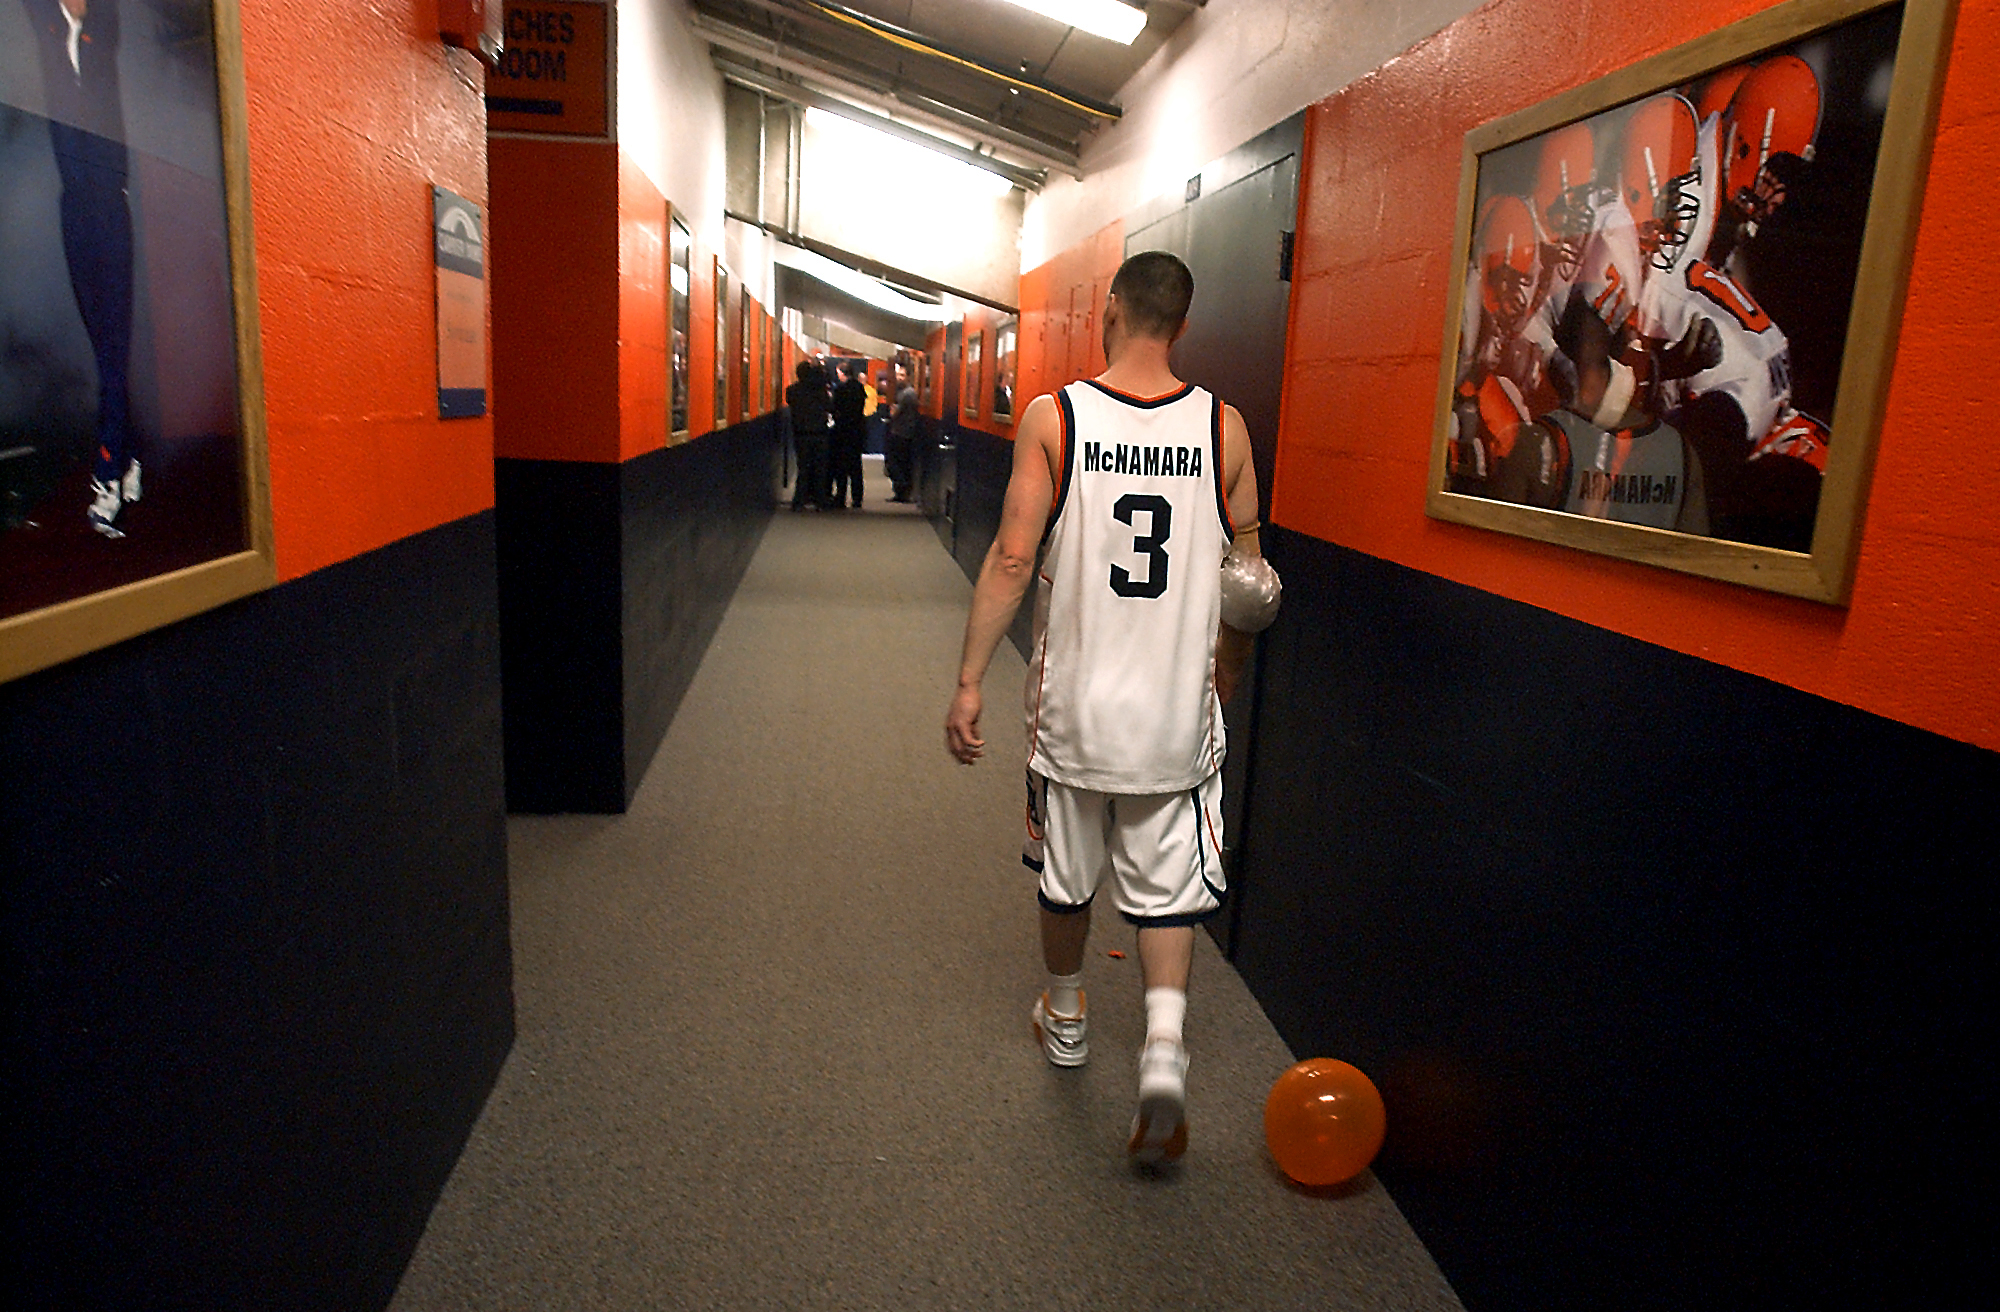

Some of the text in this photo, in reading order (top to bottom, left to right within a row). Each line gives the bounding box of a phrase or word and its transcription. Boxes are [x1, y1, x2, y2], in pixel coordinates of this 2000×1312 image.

[505, 9, 575, 43] CHES
[1085, 442, 1202, 477] McNAMARA
[1110, 495, 1172, 599] 3
